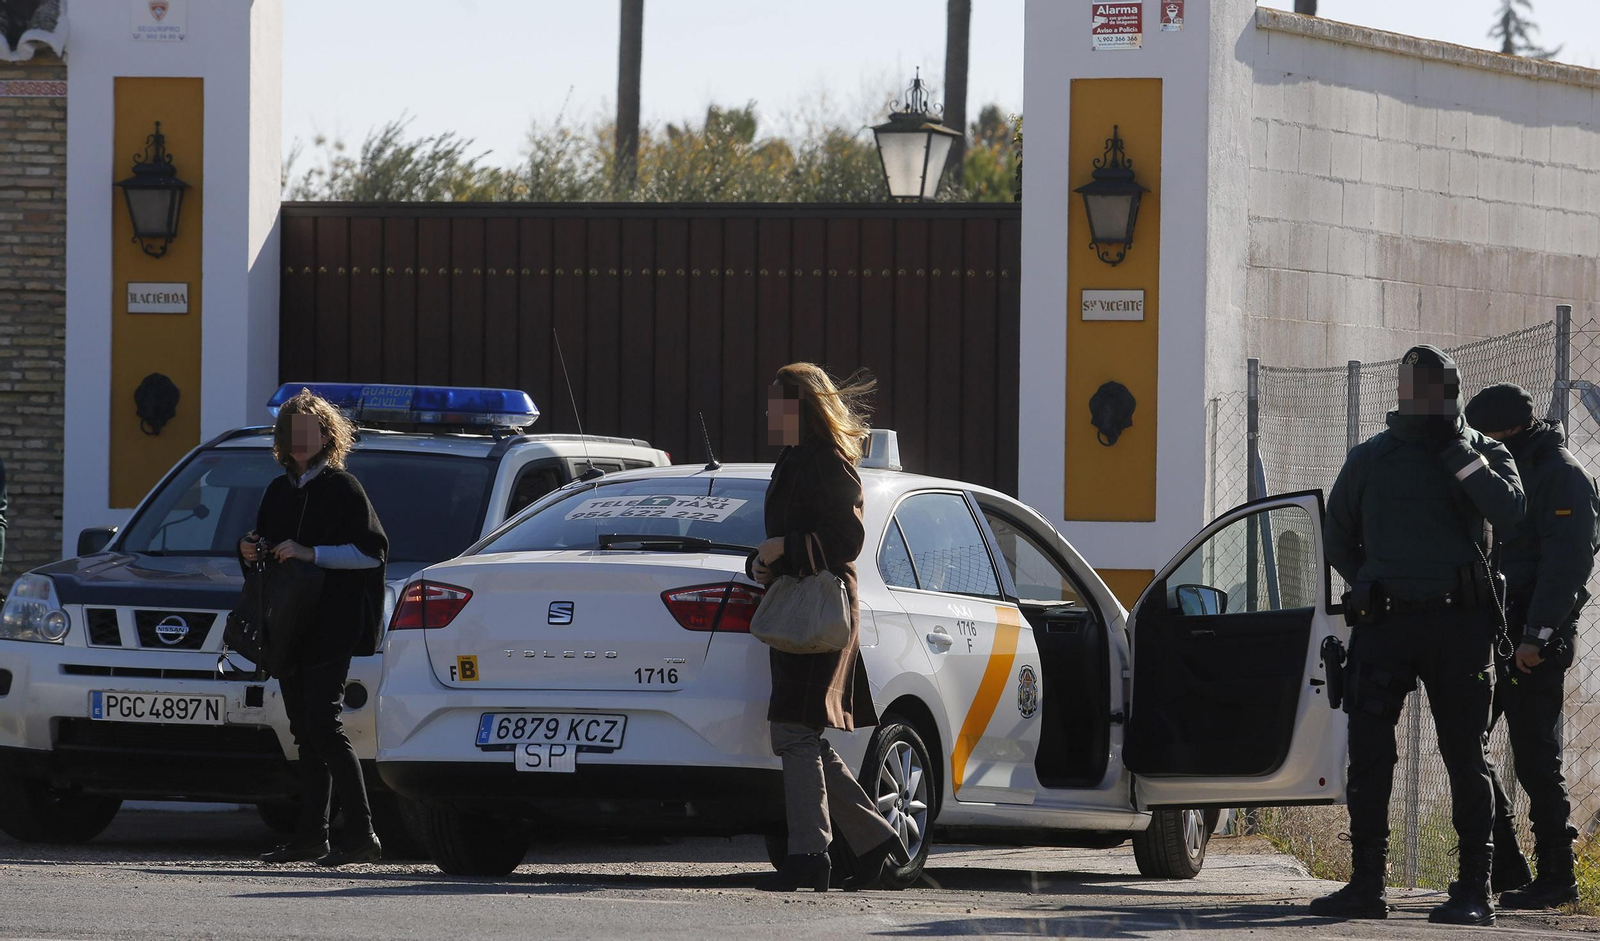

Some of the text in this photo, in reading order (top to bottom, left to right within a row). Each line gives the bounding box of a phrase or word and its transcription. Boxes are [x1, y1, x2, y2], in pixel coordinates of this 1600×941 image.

[1096, 5, 1138, 14] Alarma
[1099, 300, 1143, 312] VICENTE
[361, 387, 413, 397] GUARDIA
[370, 397, 396, 406] CIVIL
[589, 500, 641, 509] TELE
[676, 500, 730, 510] TAXI
[570, 509, 720, 521] 954 622 222
[956, 620, 978, 637] 1716
[966, 638, 973, 653] F
[503, 649, 618, 659] TOLEDO
[450, 665, 457, 681] F
[460, 660, 476, 679] B
[634, 668, 679, 684] 1716
[94, 707, 101, 715] E
[496, 717, 560, 740] 6879
[566, 718, 619, 743] KCZ
[524, 743, 567, 768] SP
